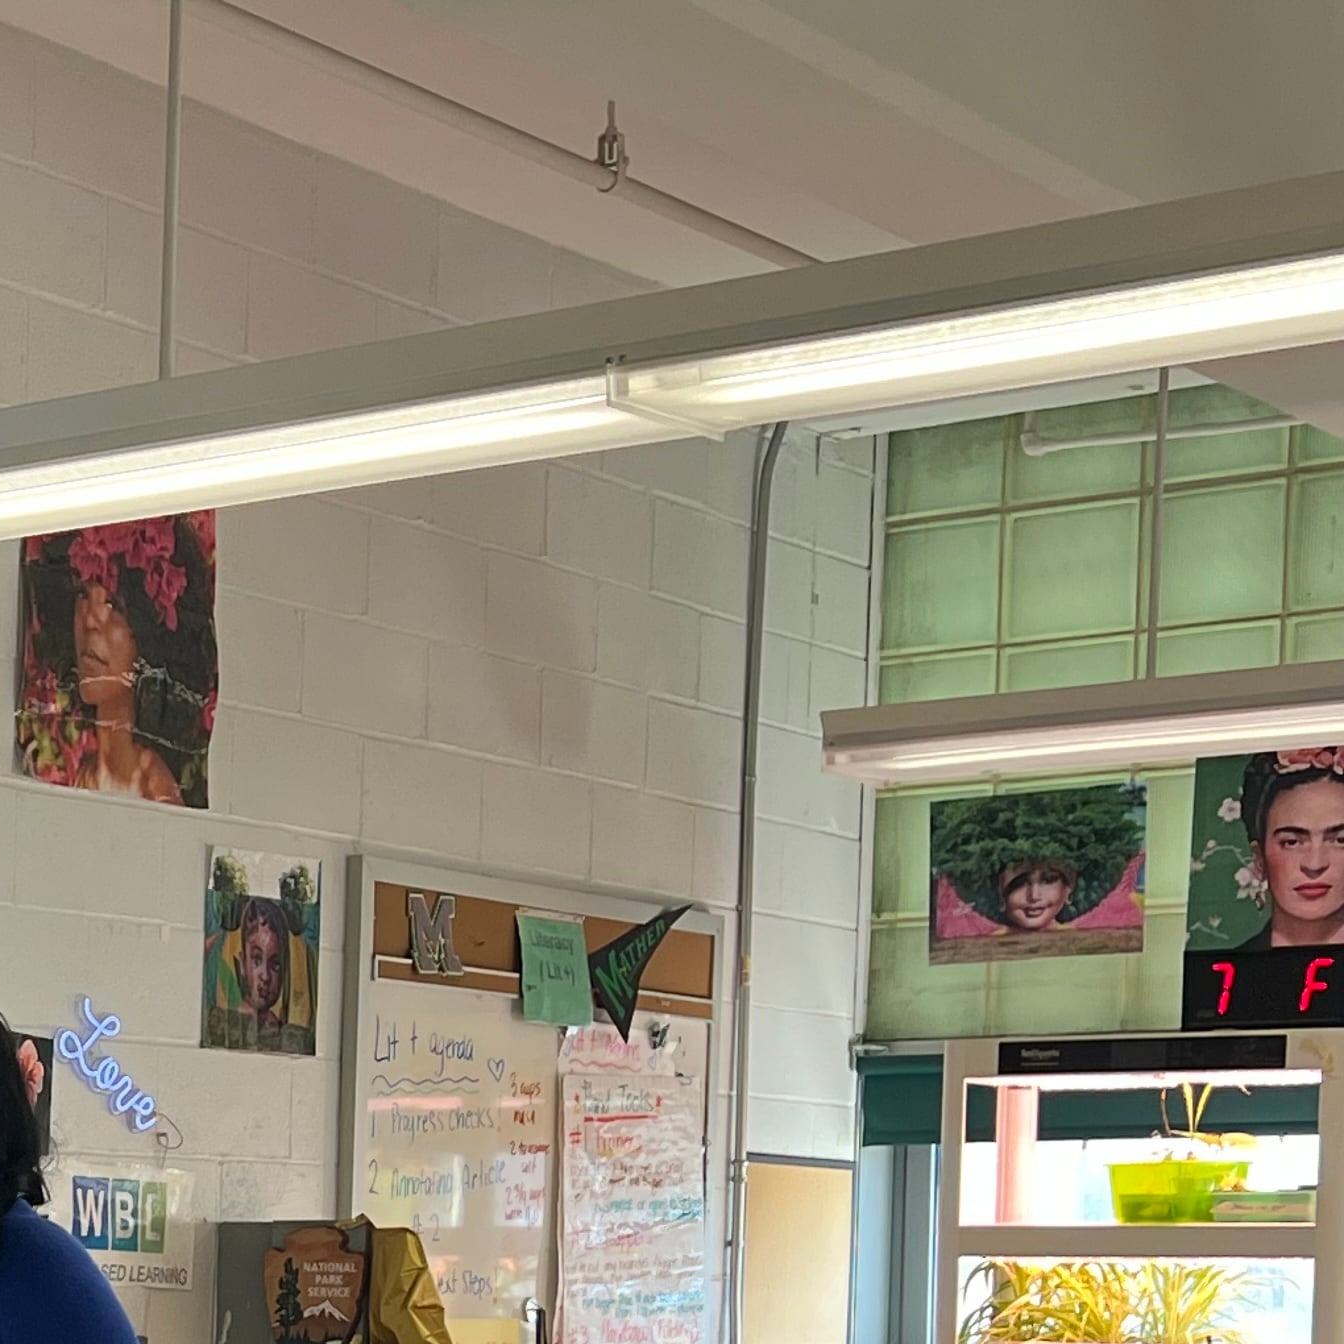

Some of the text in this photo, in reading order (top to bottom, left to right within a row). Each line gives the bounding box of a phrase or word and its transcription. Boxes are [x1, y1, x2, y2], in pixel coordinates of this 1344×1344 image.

[1213, 958, 1336, 1014] 7 F
[59, 997, 156, 1131] Love
[429, 1031, 474, 1077] agenda
[391, 1102, 445, 1146] Progress
[368, 1158, 507, 1211] 2 Annotating Article
[75, 1186, 163, 1241] WBL
[430, 1213, 441, 1242] 2
[128, 1265, 188, 1287] LEARNING
[302, 1261, 357, 1274] NATIONAL
[315, 1274, 344, 1286] PARK
[307, 1286, 351, 1299] SERVICE
